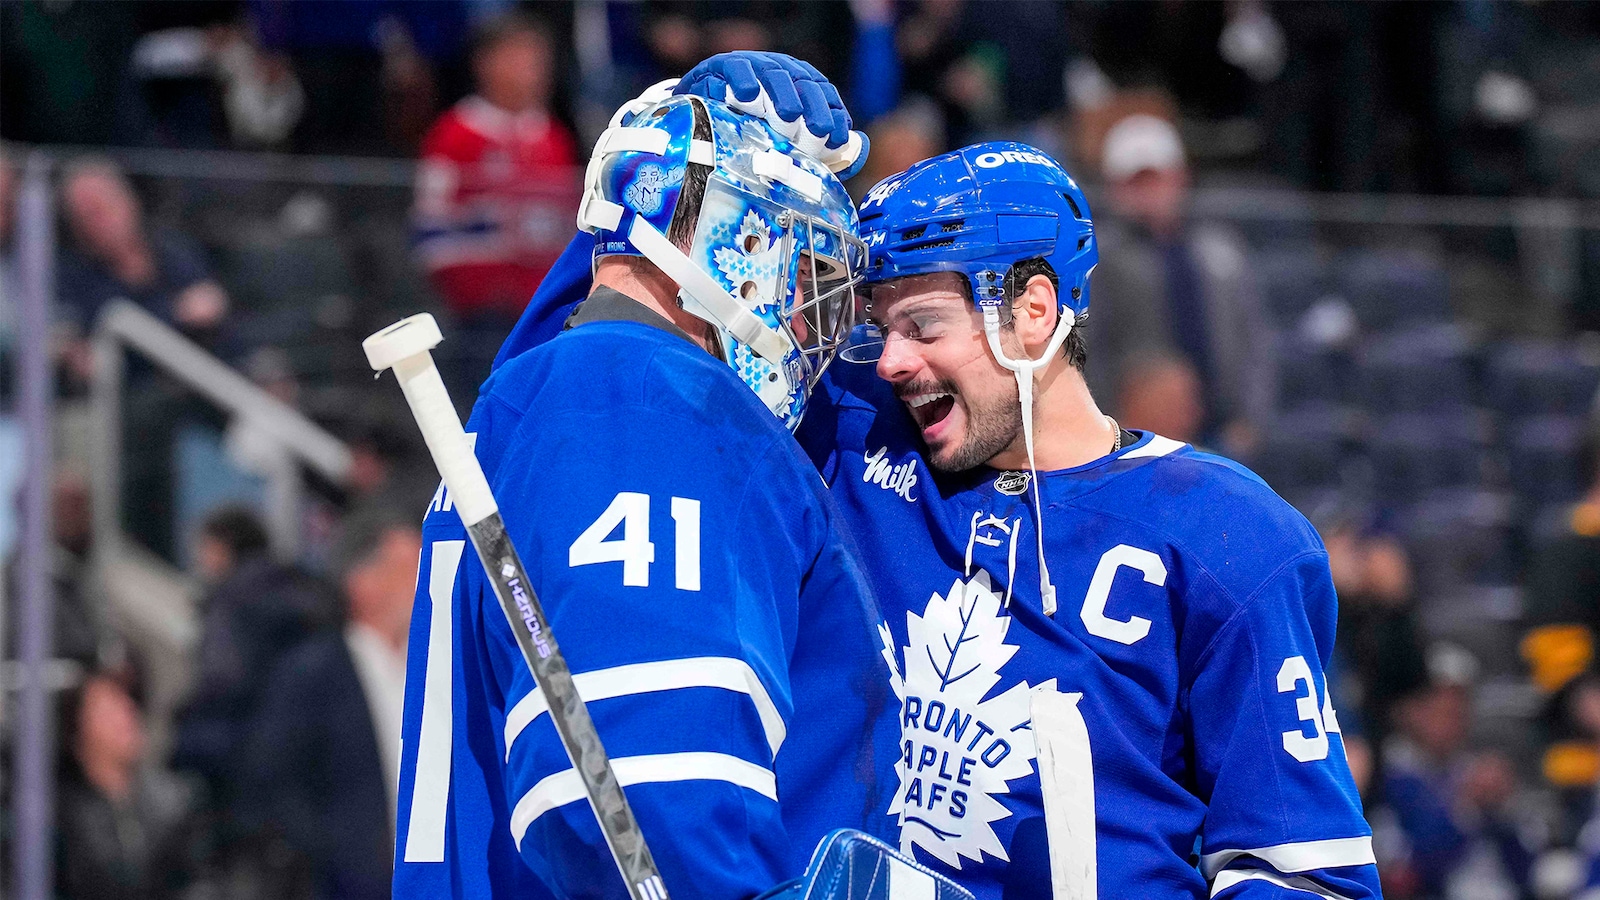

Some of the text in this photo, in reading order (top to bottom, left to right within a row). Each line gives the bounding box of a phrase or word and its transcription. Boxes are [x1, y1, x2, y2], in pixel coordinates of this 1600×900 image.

[975, 151, 1059, 170] OREO
[606, 242, 626, 252] WRONG
[863, 446, 917, 502] Milk
[568, 491, 701, 592] 41
[1079, 543, 1168, 645] C
[393, 540, 465, 871] 1
[904, 695, 1012, 768] RONTO
[904, 739, 977, 787] APLE
[904, 777, 968, 819] AFS
